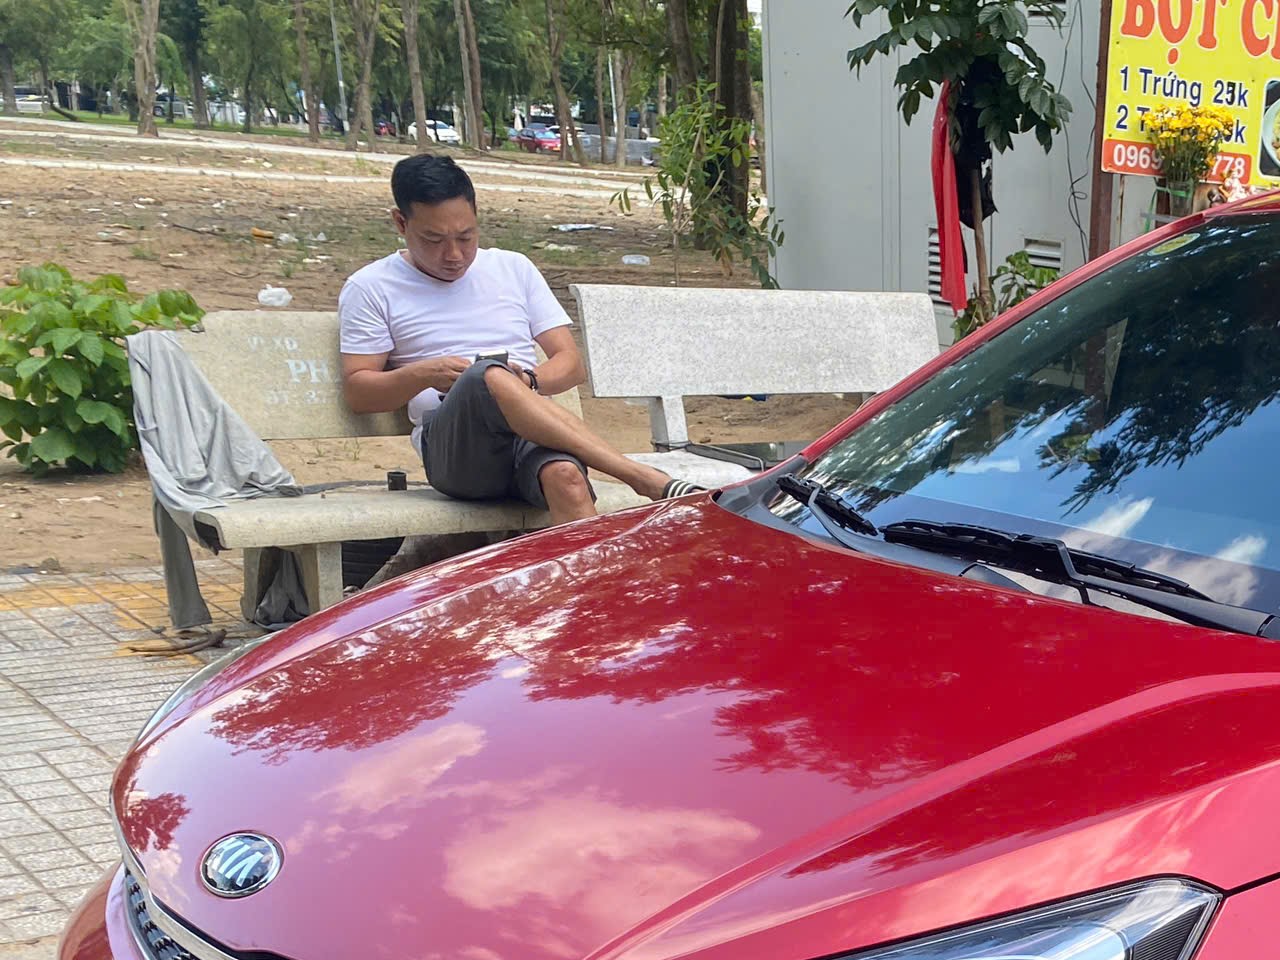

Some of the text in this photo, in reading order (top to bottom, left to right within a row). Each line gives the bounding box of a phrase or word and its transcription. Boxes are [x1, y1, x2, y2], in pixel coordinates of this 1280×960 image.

[1120, 66, 1128, 91] 1
[1139, 68, 1201, 107] Trứng
[1116, 105, 1128, 129] 2
